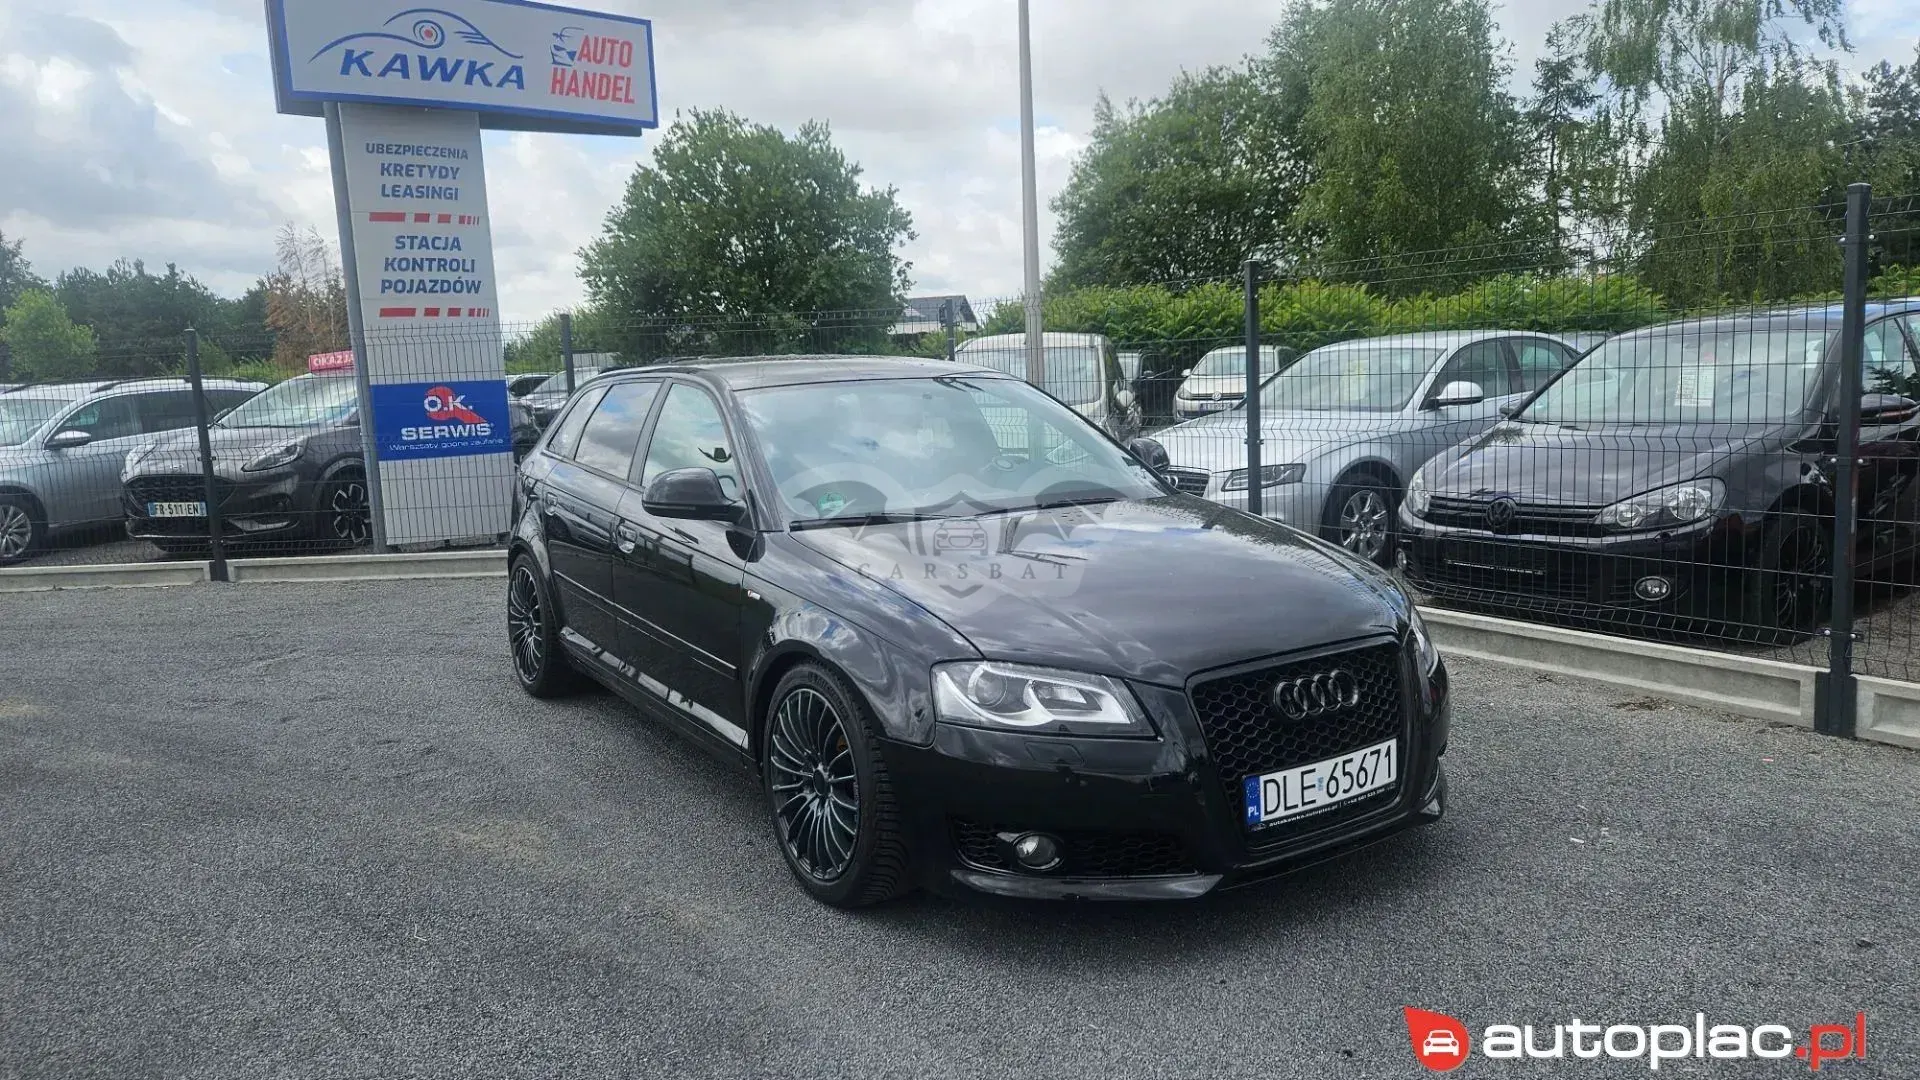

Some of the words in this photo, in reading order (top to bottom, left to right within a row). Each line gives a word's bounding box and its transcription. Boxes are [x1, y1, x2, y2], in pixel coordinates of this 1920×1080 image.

[577, 34, 634, 68] AUTO
[339, 48, 526, 91] KAWKA
[550, 65, 636, 105] HANDEL
[365, 142, 469, 161] UBEZPIECZENIA
[380, 162, 461, 180] KRETYDY
[381, 183, 459, 201] LEASINGI
[394, 234, 462, 251] STACJA
[383, 257, 476, 273] KONTROLI
[380, 276, 482, 294] POJAZDÓW
[424, 394, 473, 412] O.K.
[401, 423, 492, 441] SERWIS
[1247, 805, 1260, 818] PL
[1263, 767, 1317, 817] DLE
[1325, 744, 1392, 798] 65671
